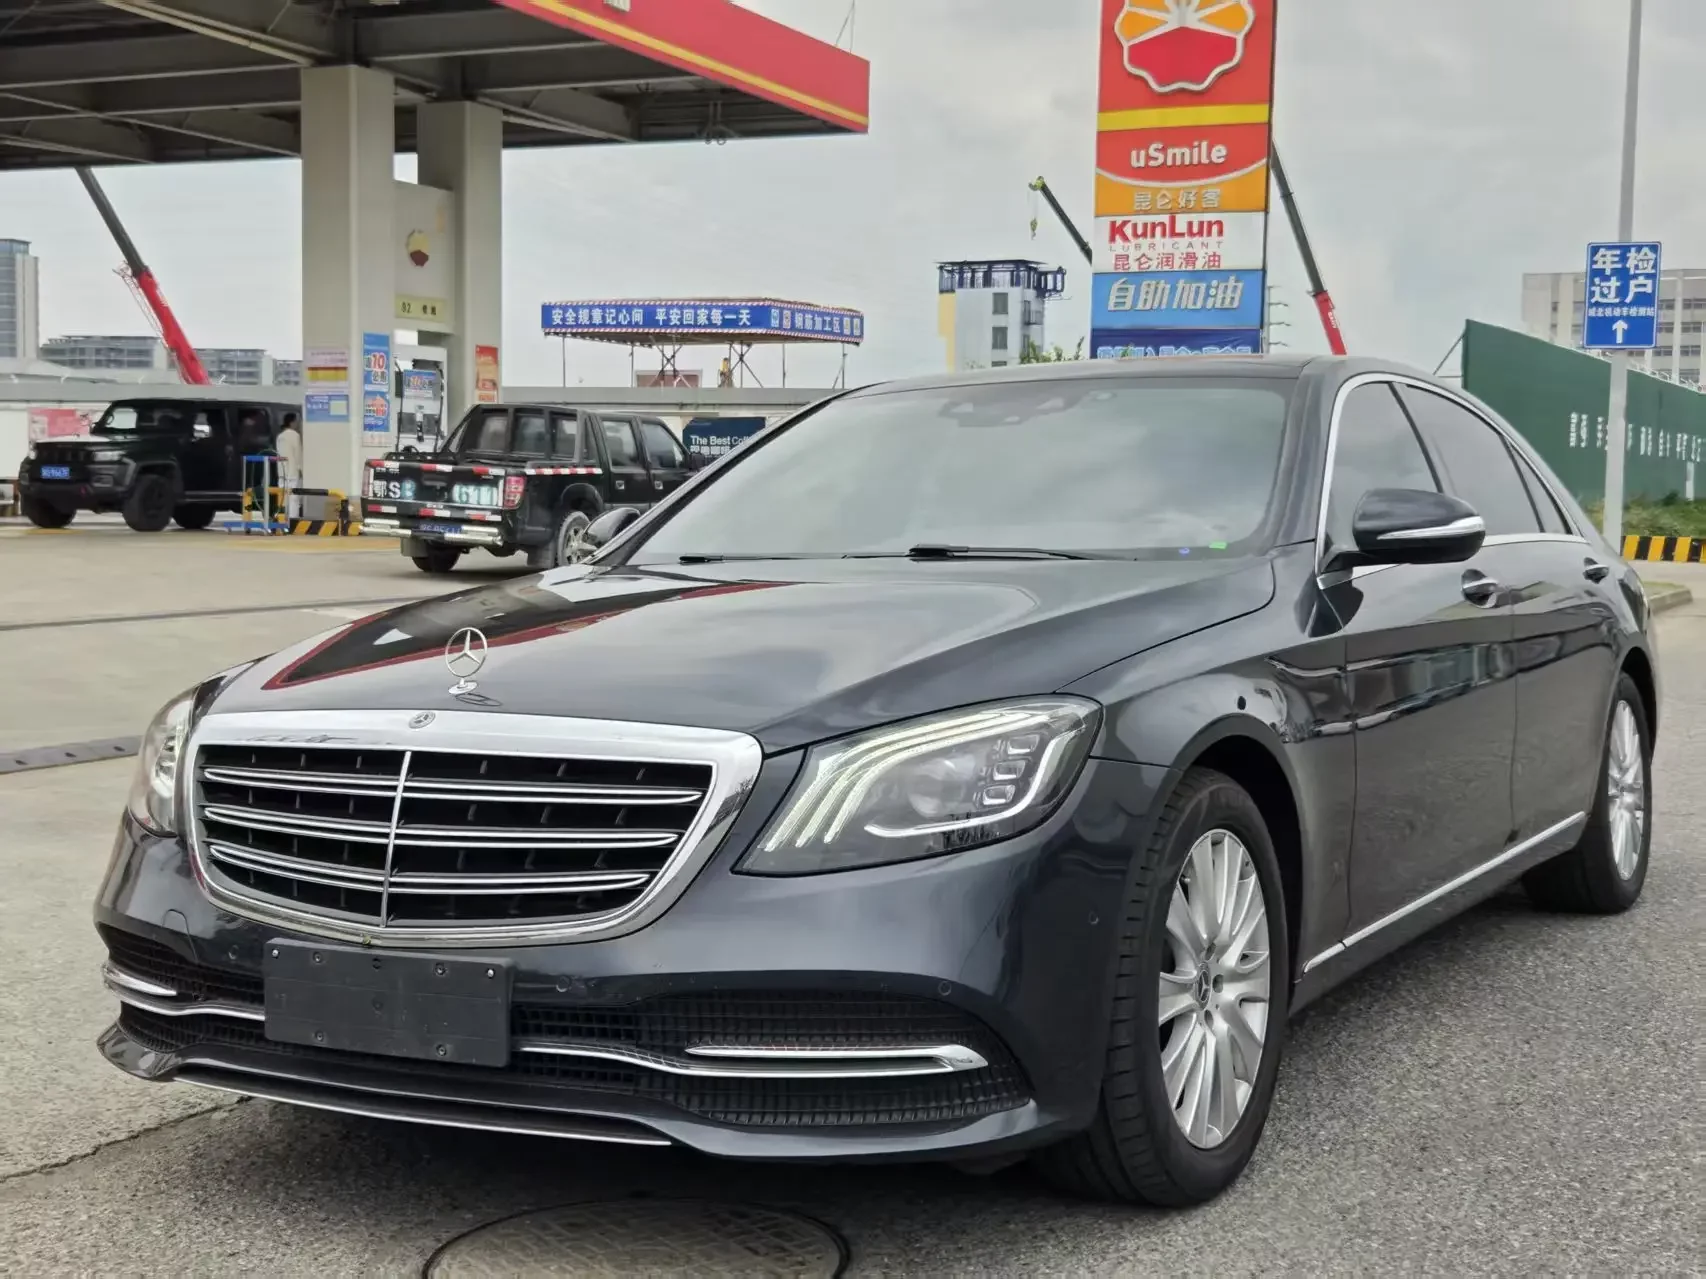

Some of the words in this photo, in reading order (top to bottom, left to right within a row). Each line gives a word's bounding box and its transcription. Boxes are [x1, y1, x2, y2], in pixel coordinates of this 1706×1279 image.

[1131, 141, 1227, 168] uSmile
[1134, 189, 1221, 210] 昆仑好客
[1108, 214, 1224, 244] KunLun
[1109, 241, 1223, 252] LUBRICANT
[1113, 251, 1222, 271] 昆仑润滑油
[1592, 247, 1656, 275] 年检
[1108, 274, 1244, 311] 自助加油
[1590, 276, 1653, 304] 过户
[655, 308, 750, 326] 平安回家每一天
[690, 435, 708, 445] The
[710, 435, 731, 446] Best
